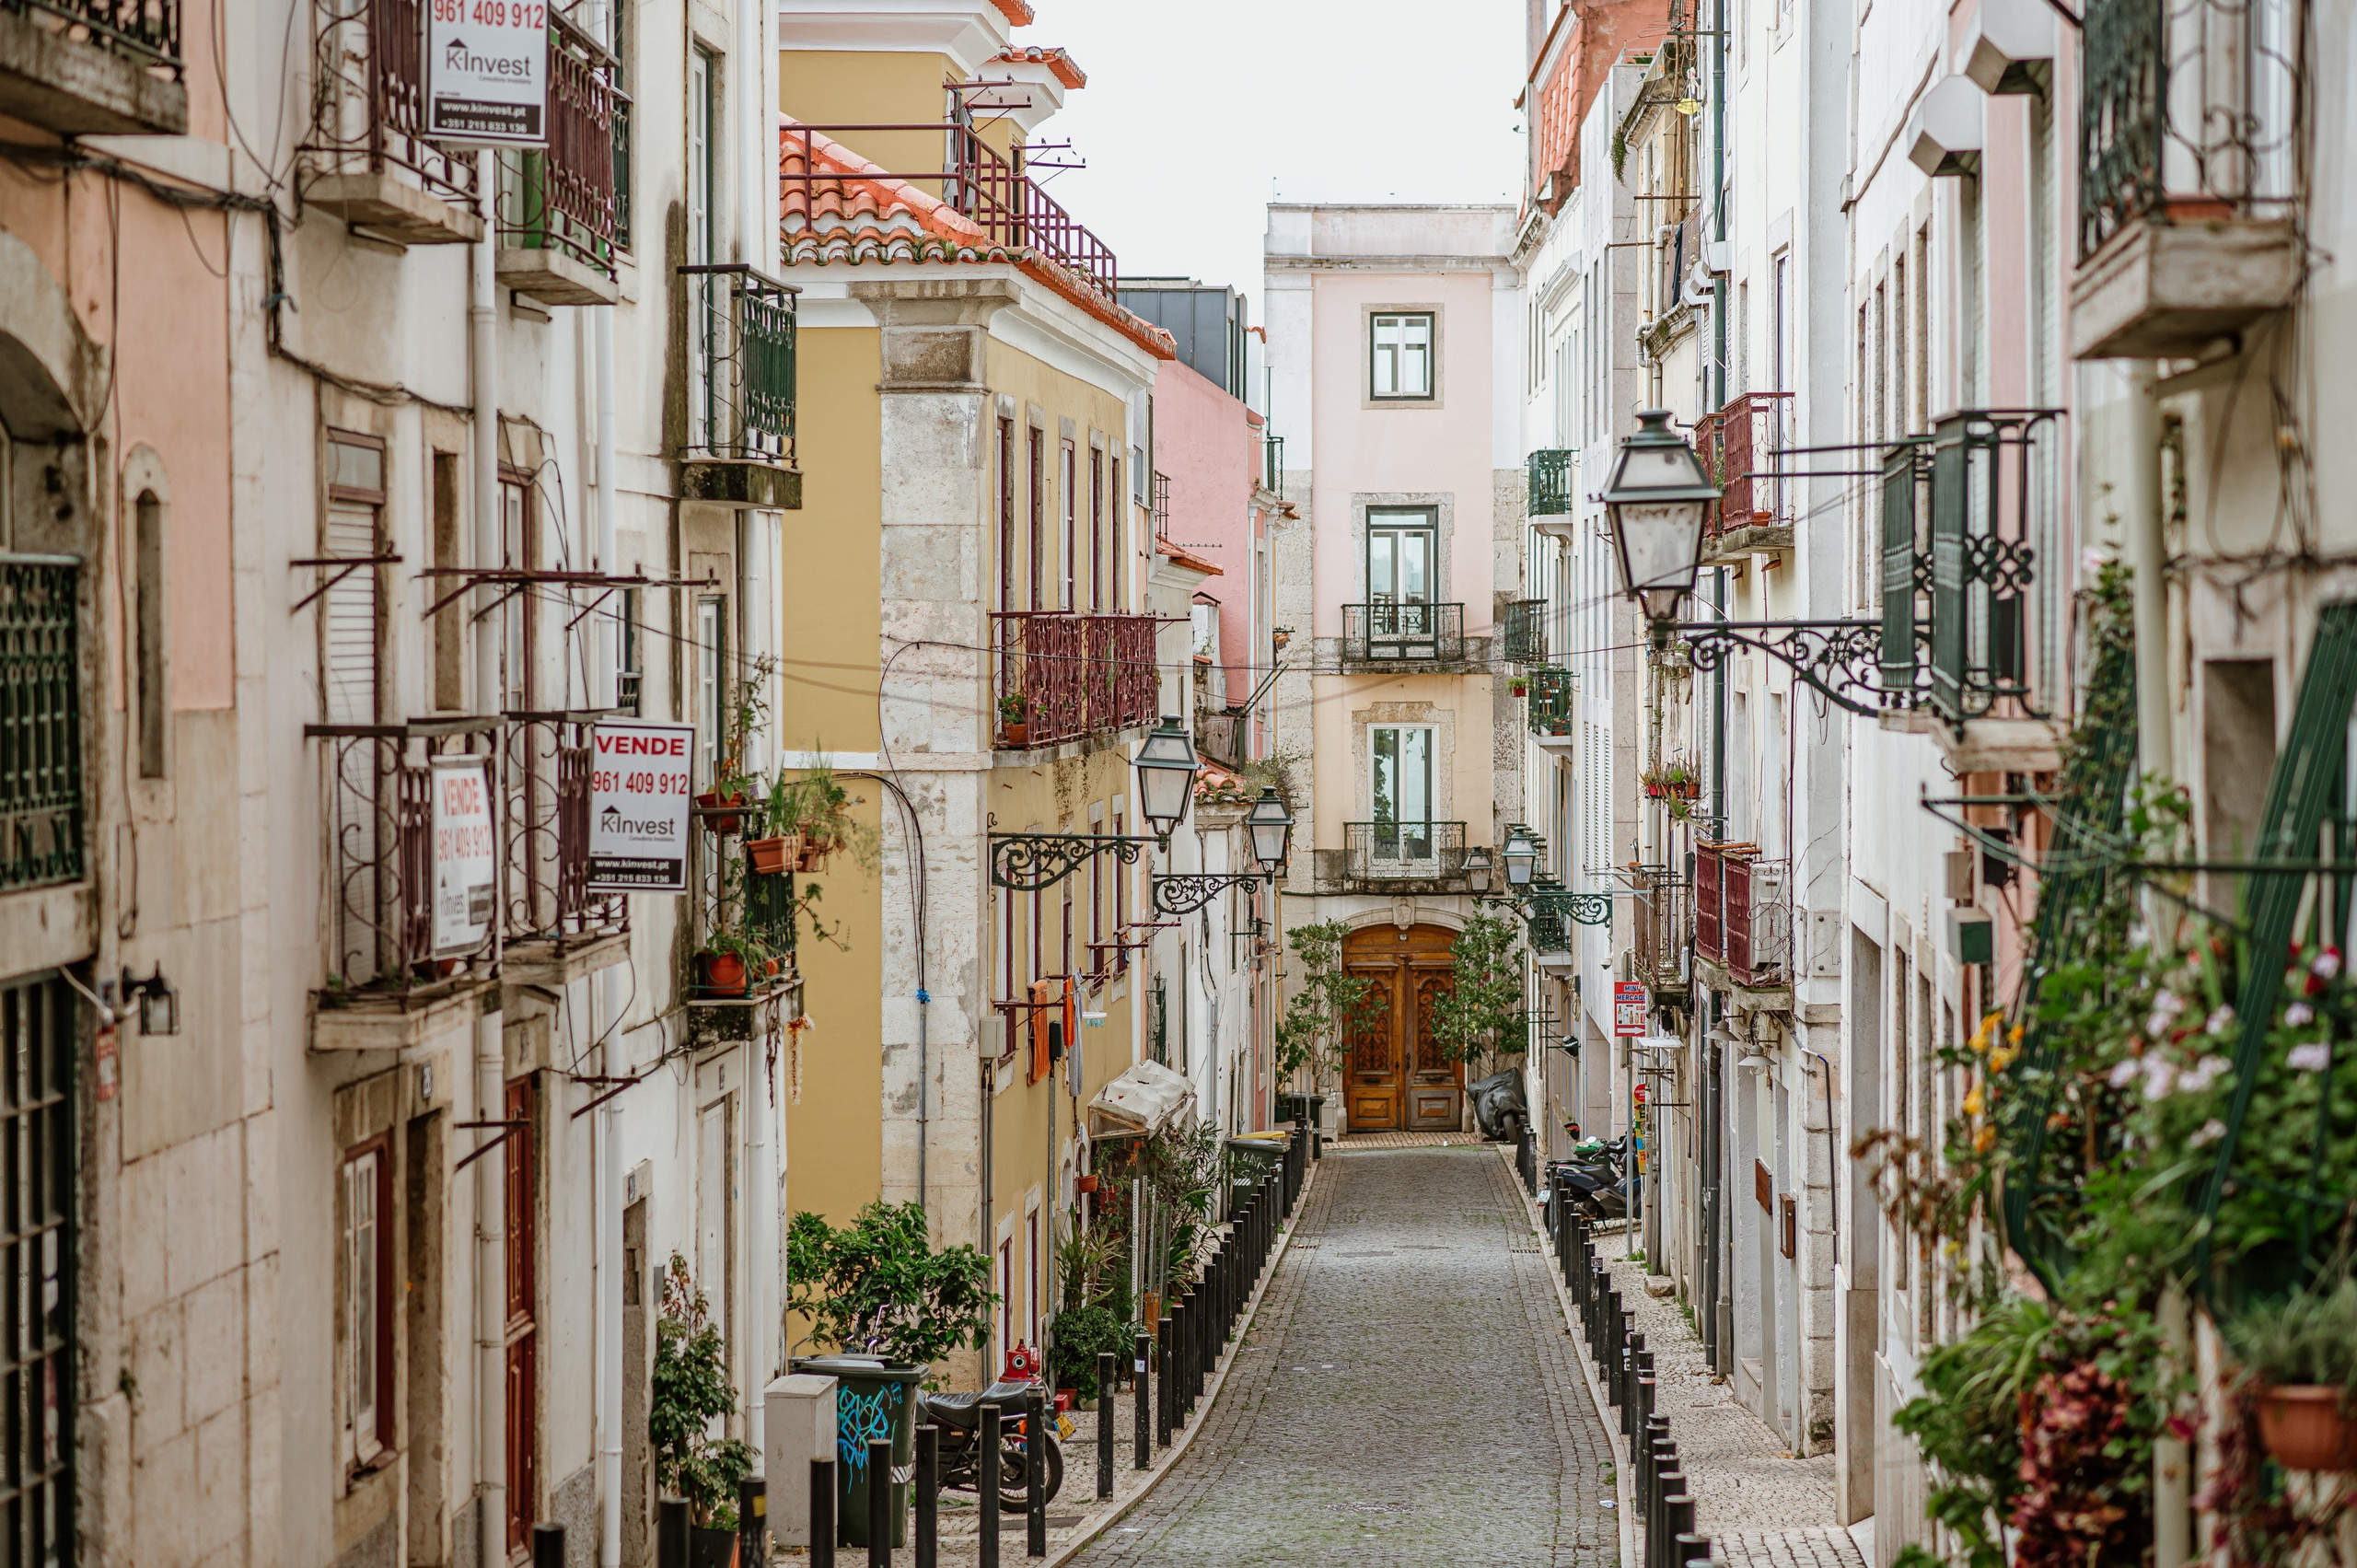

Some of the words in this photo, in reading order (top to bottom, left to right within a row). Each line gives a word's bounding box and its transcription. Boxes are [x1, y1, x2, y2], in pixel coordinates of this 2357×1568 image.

[435, 0, 465, 23] 961
[472, 1, 505, 27] 409
[512, 3, 545, 29] 912
[440, 101, 527, 119] www.kinvest.pt
[596, 735, 685, 756] VENDE
[592, 771, 620, 793] 961
[626, 772, 654, 794] 409
[659, 773, 688, 796] 912
[440, 777, 482, 817] VENDE
[438, 828, 454, 862] 961
[455, 826, 470, 858] 409
[473, 825, 491, 857] 912
[595, 858, 669, 871] www.kinvest.pt
